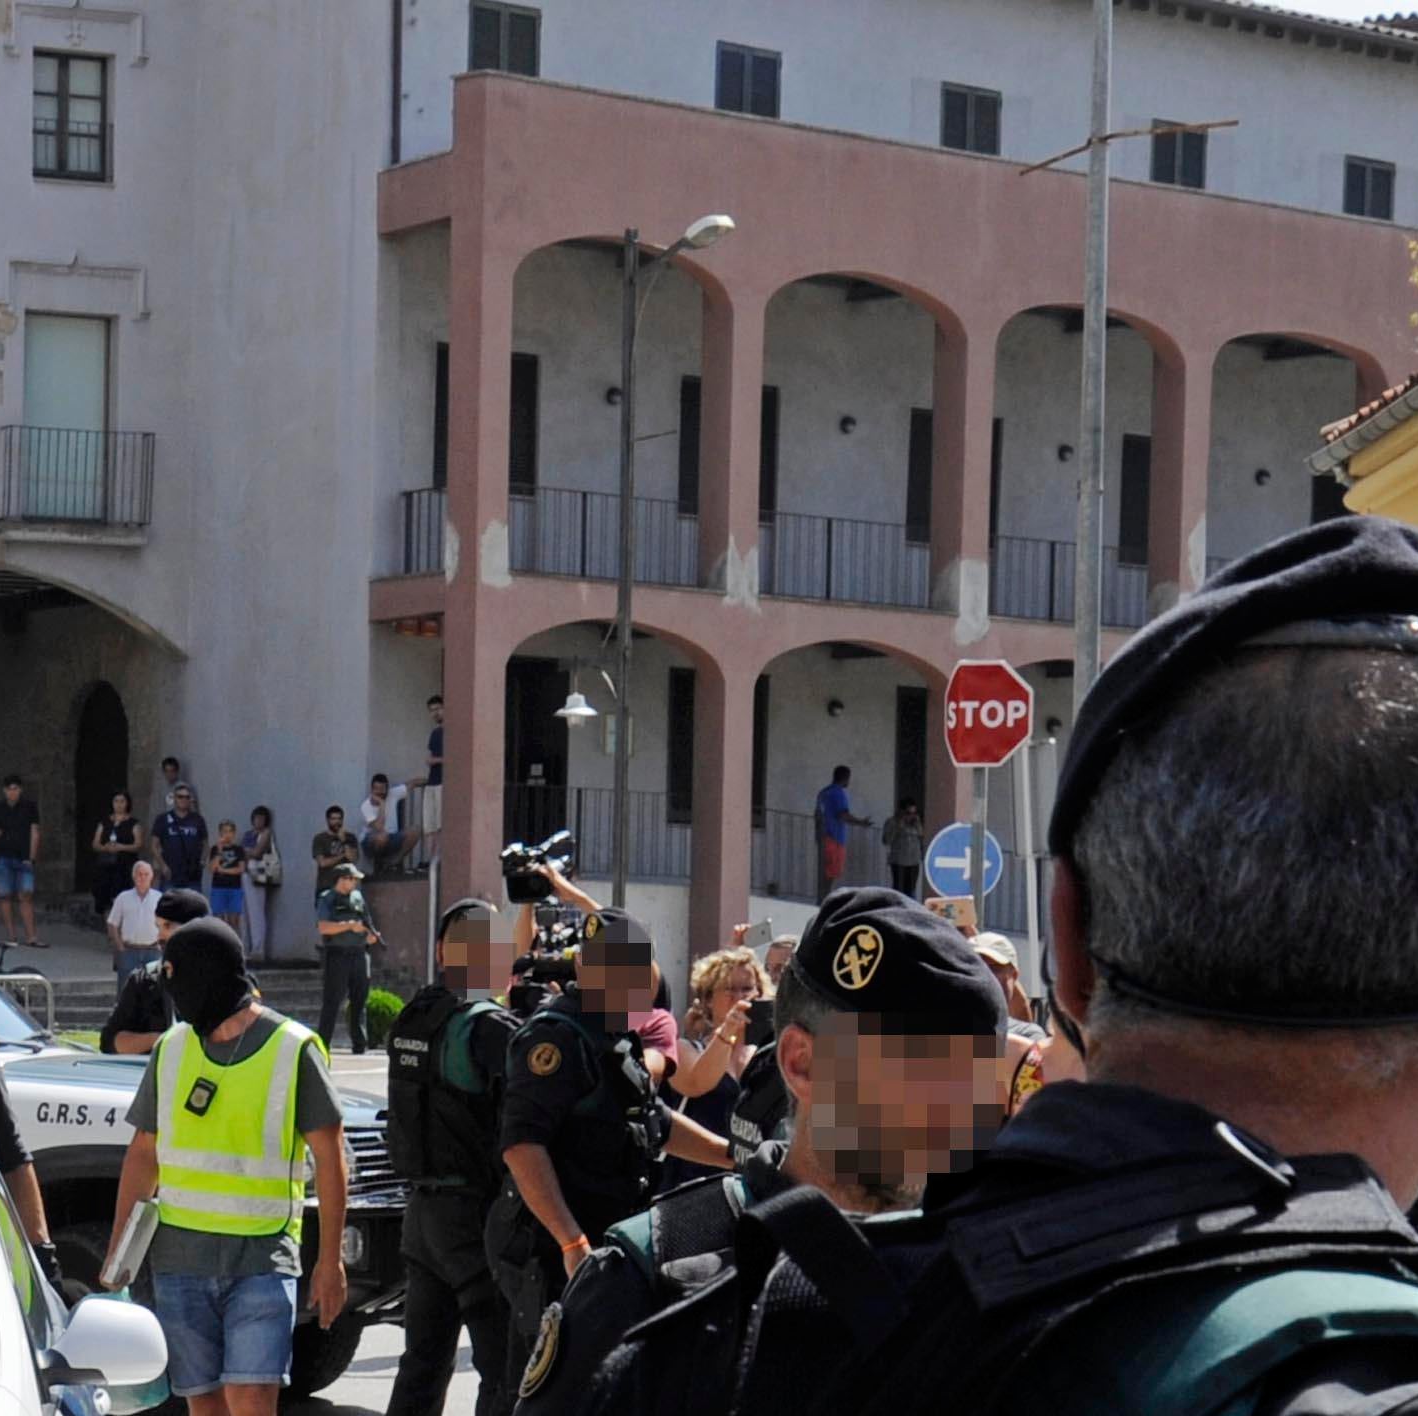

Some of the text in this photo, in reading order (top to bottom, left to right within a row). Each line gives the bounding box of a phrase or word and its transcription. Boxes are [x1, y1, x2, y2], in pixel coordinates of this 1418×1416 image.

[947, 699, 1028, 730] STOP
[393, 1036, 429, 1053] GUARDIA
[36, 1101, 117, 1128] G.R.S. 4
